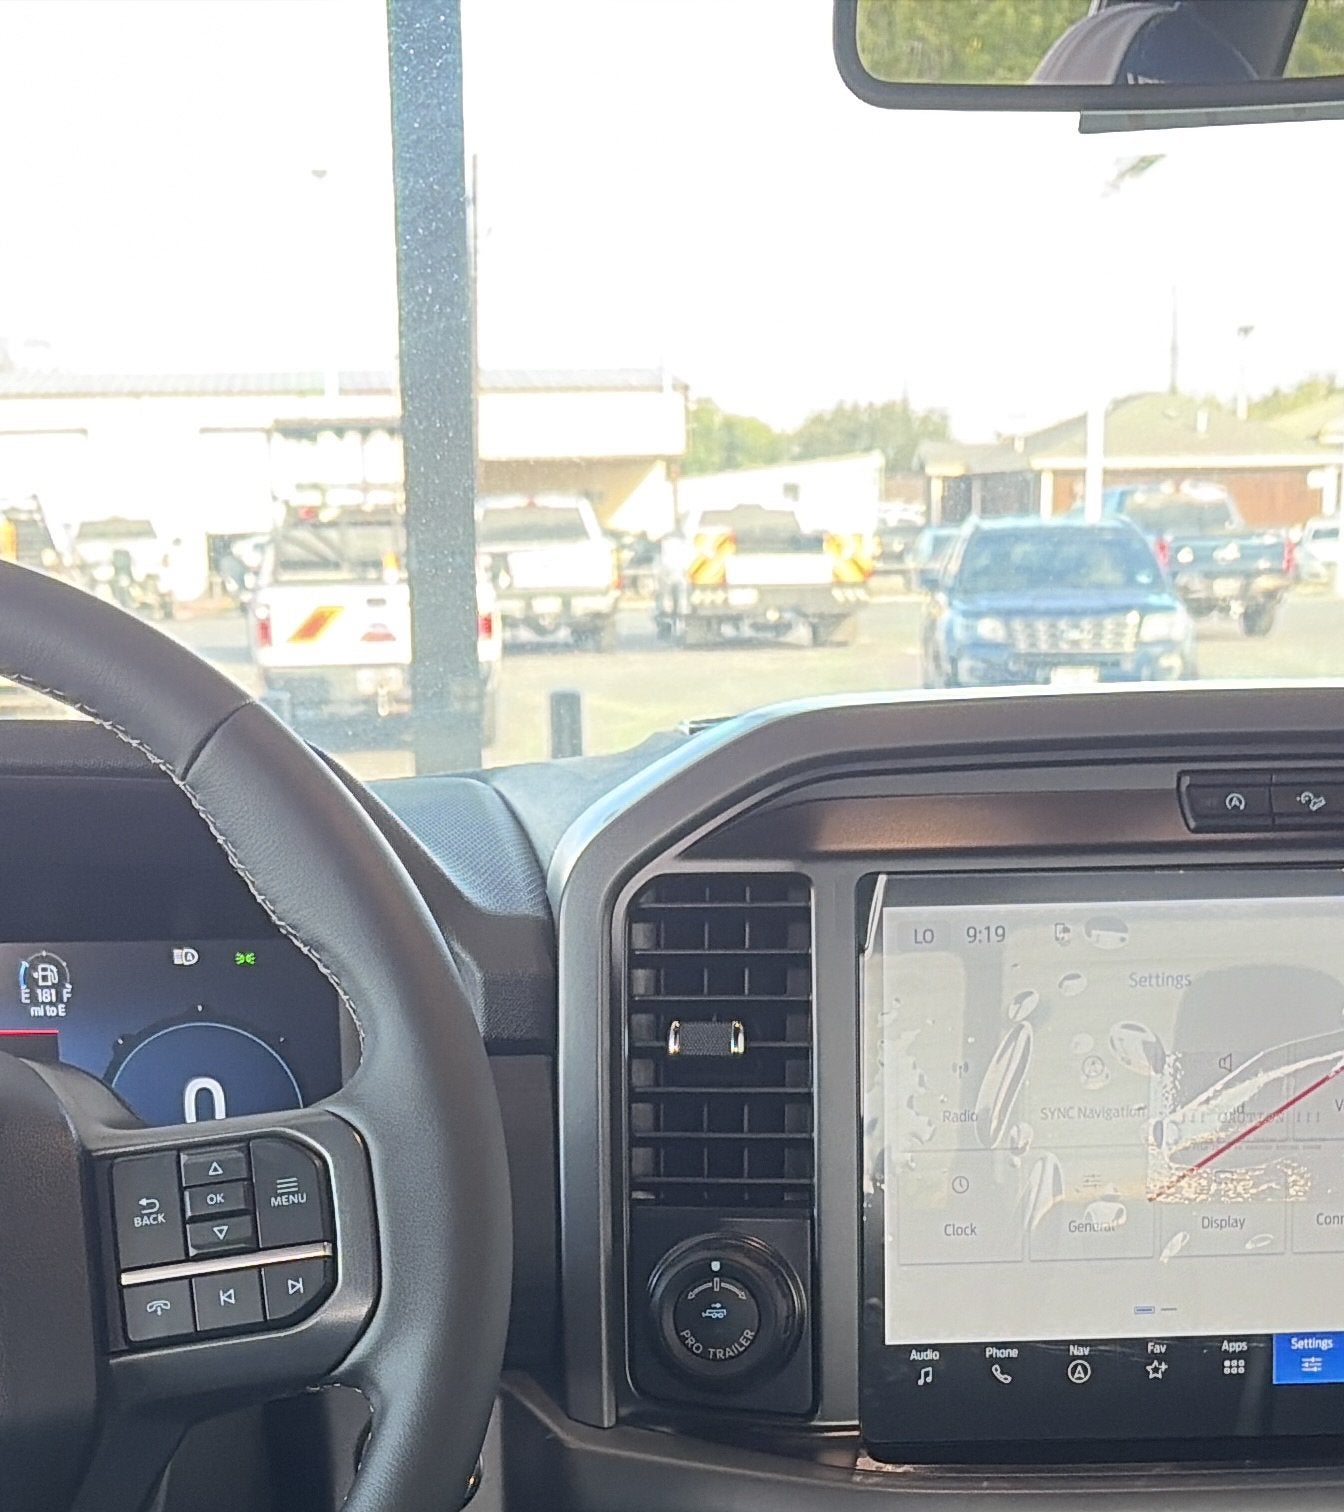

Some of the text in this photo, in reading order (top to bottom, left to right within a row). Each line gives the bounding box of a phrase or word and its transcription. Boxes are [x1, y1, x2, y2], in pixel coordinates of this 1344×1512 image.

[913, 925, 1006, 945] LO 9:19
[1128, 971, 1193, 989] Settings
[20, 988, 73, 1003] E 181 F
[30, 1005, 66, 1017] mi to E
[942, 1110, 978, 1123] Radio
[1041, 1104, 1146, 1121] SYNC Navigation
[206, 1193, 225, 1205] OK
[270, 1192, 307, 1207] MENU
[134, 1213, 166, 1227] BACK
[1201, 1215, 1246, 1231] Display
[943, 1222, 977, 1237] Clock
[679, 1328, 755, 1360] PRO TRAILER
[1069, 1344, 1090, 1356] Nav
[1147, 1342, 1167, 1354] Fav
[1221, 1340, 1248, 1353] Apps
[1290, 1337, 1334, 1350] Settings
[909, 1349, 940, 1361] Audio
[985, 1347, 1019, 1359] Phone
